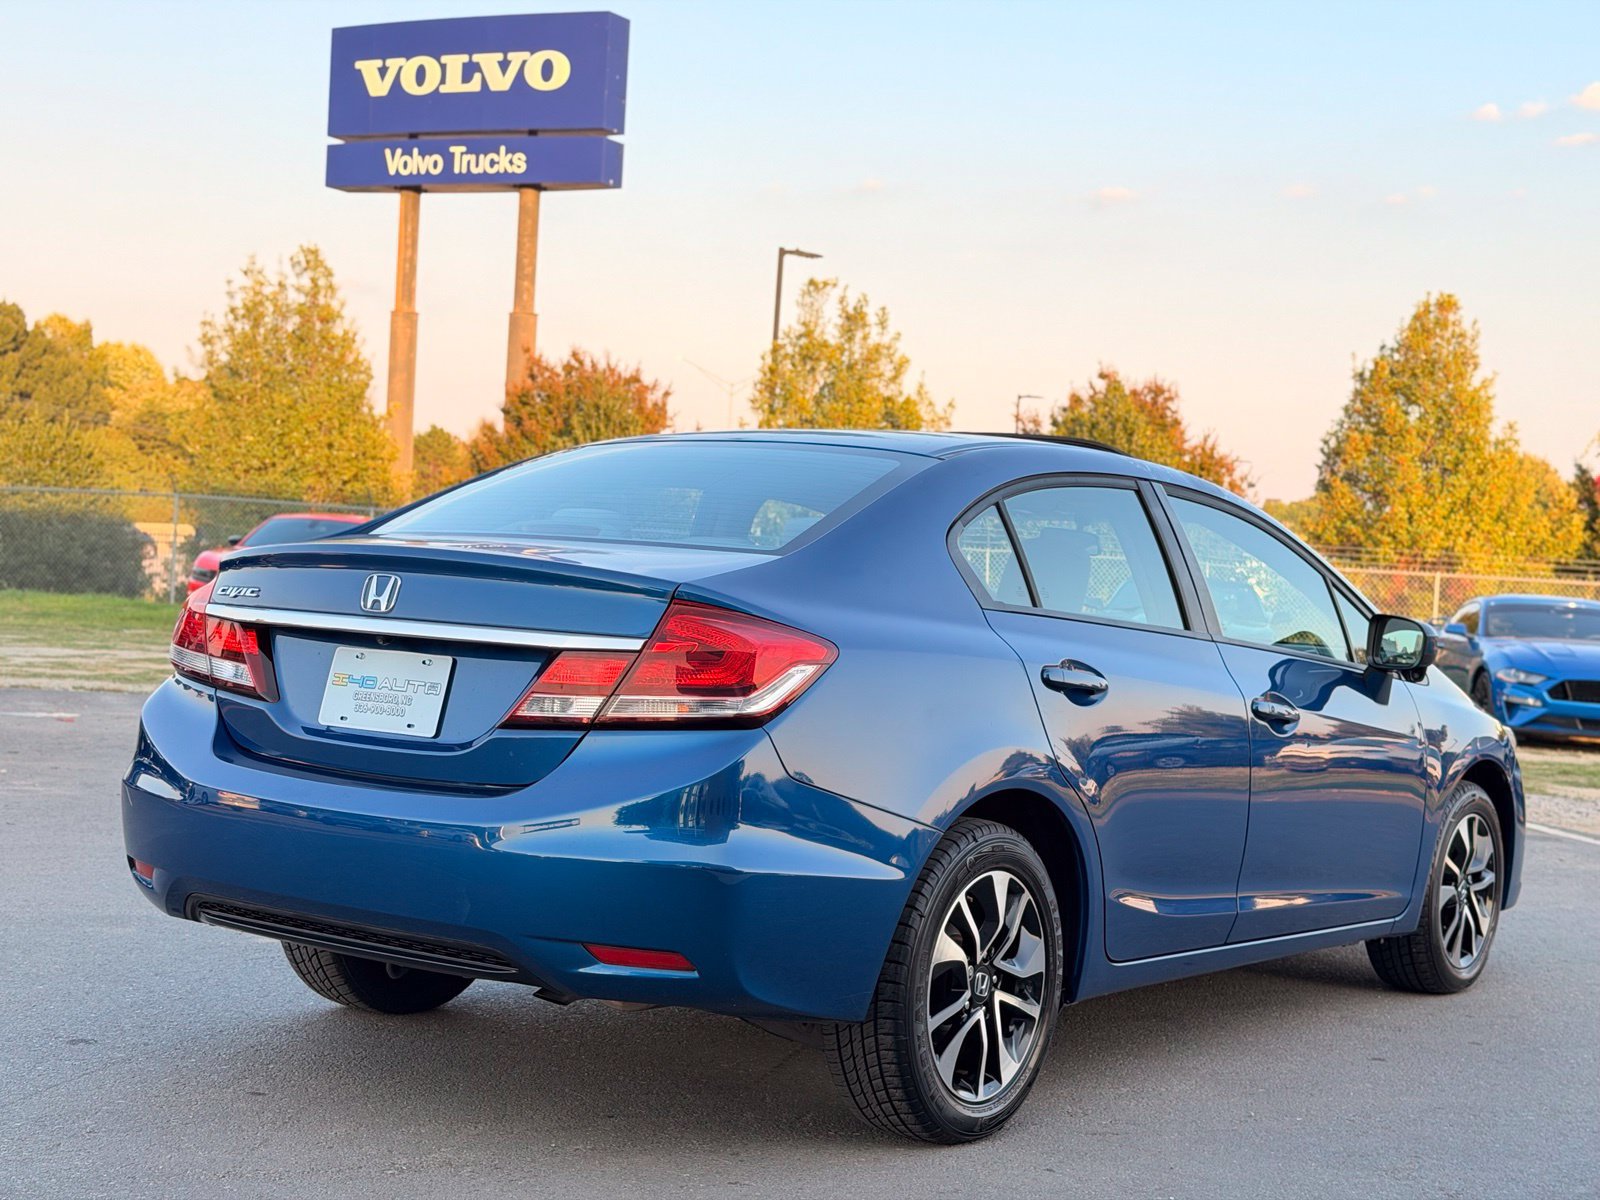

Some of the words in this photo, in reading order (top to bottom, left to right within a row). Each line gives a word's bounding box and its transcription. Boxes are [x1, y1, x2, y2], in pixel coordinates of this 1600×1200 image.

[354, 50, 571, 97] VOLVO
[384, 148, 443, 176] Volvo
[449, 145, 527, 175] Trucks
[217, 585, 261, 598] CIVIC
[400, 694, 413, 706] NC
[354, 702, 406, 717] 336-900-8000
